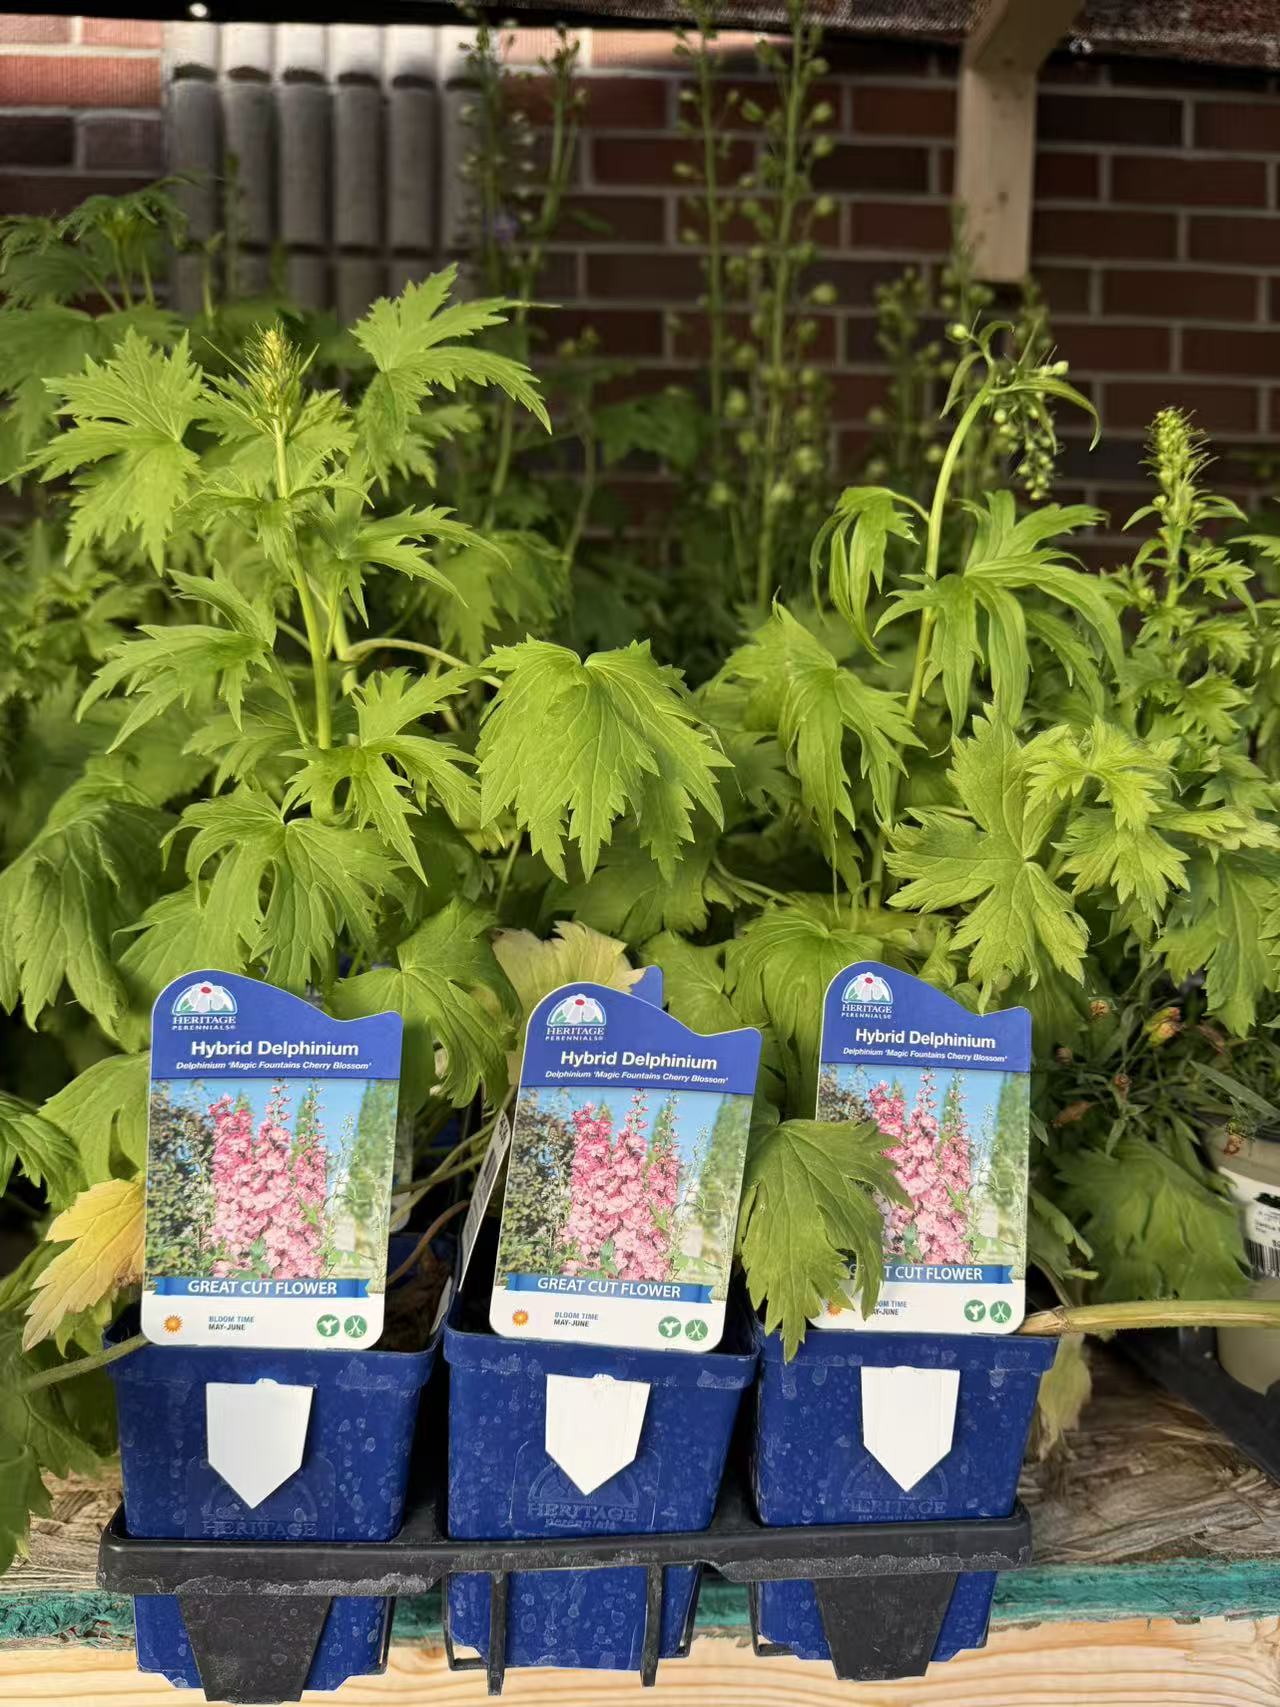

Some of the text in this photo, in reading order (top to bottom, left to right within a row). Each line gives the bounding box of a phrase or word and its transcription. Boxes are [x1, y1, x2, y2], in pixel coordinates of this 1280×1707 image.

[842, 1004, 892, 1013] HERITAGE
[173, 1015, 237, 1024] HERITAGE
[547, 1027, 605, 1036] HERITAGE
[855, 1028, 995, 1048] Hybrid Delphinium
[191, 1041, 359, 1058] Hybrid Delphinium
[843, 1047, 883, 1057] Delphinium
[910, 1051, 945, 1059] Fountains
[947, 1053, 972, 1062] Cherry
[561, 1050, 717, 1070] Hybrid Delphinium
[176, 1061, 226, 1070] Delphinium
[258, 1061, 301, 1069] Fountains
[303, 1062, 332, 1071] Cherry
[545, 1070, 591, 1079] Delphinium
[621, 1073, 661, 1081] Fountains
[663, 1074, 690, 1083] Cherry
[895, 1266, 922, 1280] CUT
[926, 1267, 983, 1281] FLOWER
[188, 1280, 337, 1295] GREAT CUT FLOWER
[537, 1277, 681, 1299] GREAT CUT FLOWER
[891, 1301, 907, 1309] TIME
[208, 1315, 255, 1324] BLOOM TIME
[554, 1311, 599, 1321] BLOOM TIME
[208, 1323, 246, 1332] MAY-JUNE
[553, 1318, 590, 1328] MAY-JUNE
[200, 1521, 319, 1536] HERITAGE
